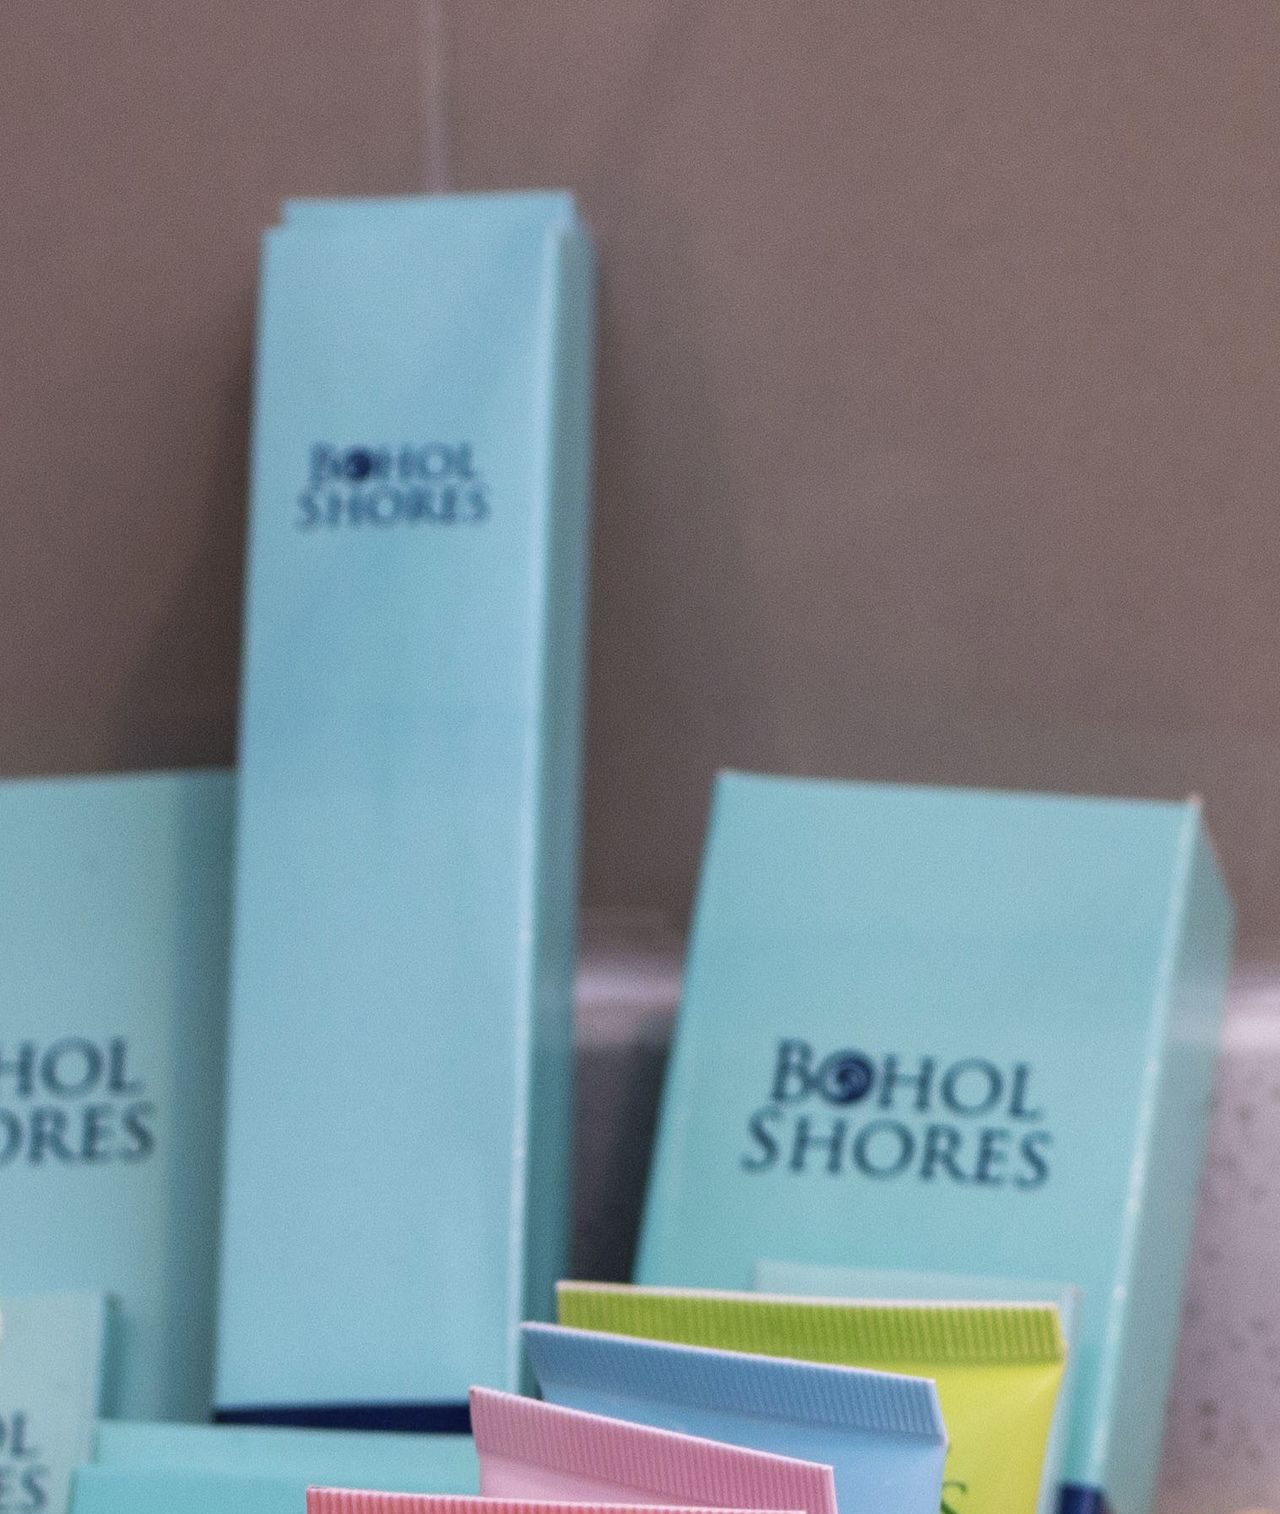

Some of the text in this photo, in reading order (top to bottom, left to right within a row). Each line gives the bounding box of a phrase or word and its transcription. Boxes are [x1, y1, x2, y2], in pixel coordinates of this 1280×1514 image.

[294, 484, 490, 530] SHORES
[773, 1037, 1043, 1119] BOHOL
[741, 1103, 1053, 1189] SHORES
